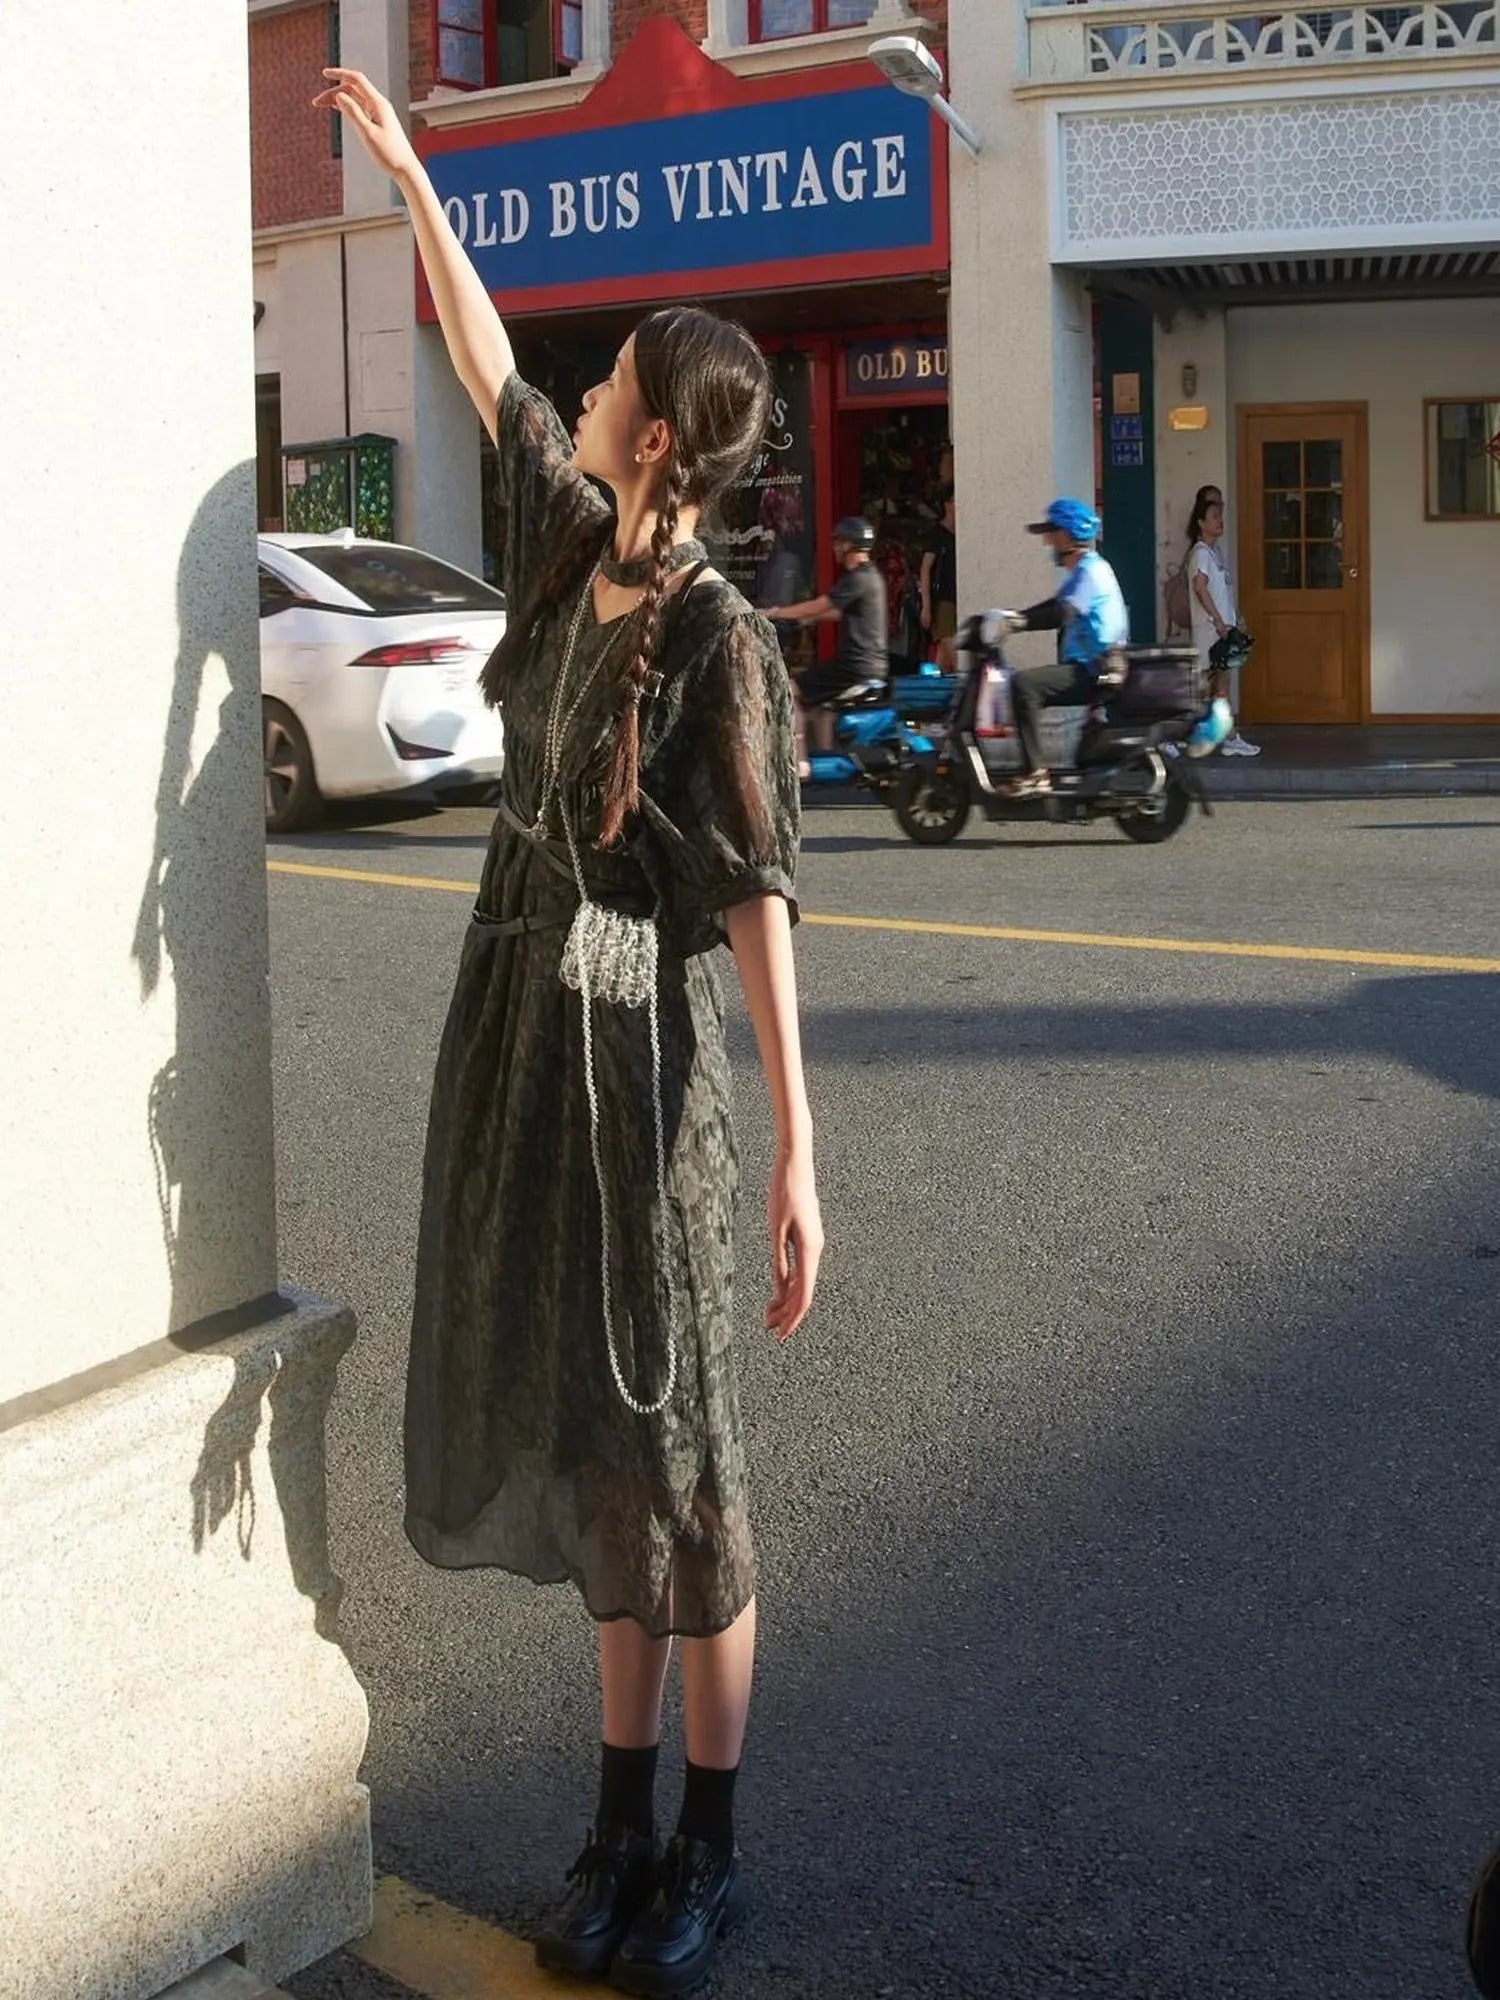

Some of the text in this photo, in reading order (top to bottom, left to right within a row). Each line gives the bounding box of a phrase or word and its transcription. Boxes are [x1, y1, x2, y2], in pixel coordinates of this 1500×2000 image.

[443, 134, 907, 248] OLD BUS VINTAGE
[857, 351, 906, 381] OLD
